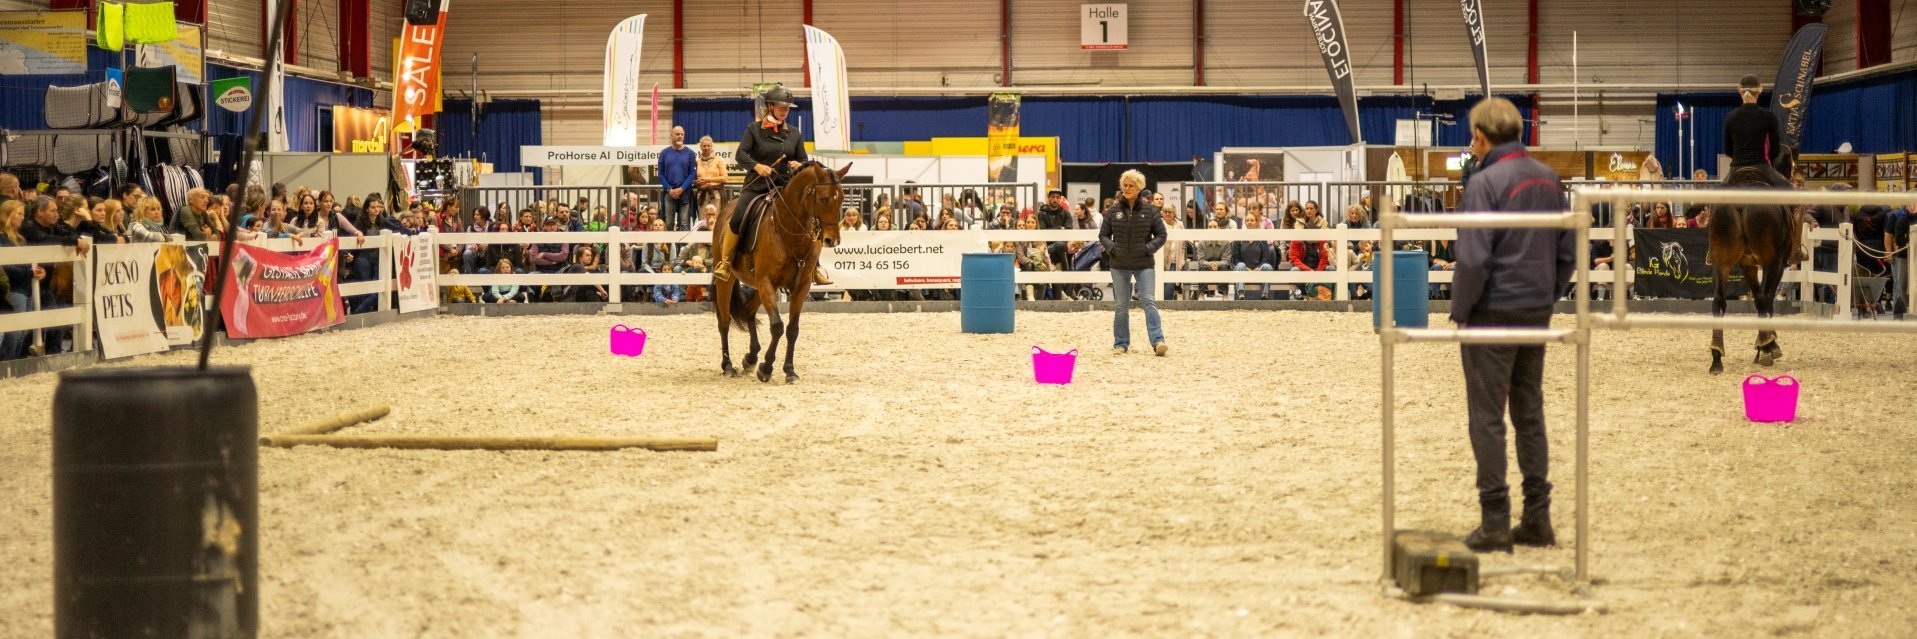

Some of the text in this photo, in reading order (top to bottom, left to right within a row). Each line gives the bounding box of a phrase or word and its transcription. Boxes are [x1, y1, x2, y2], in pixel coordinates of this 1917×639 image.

[1089, 6, 1119, 19] Halle
[1099, 20, 1108, 43] 1
[405, 25, 436, 107] SALE
[1793, 48, 1813, 99] SCHNABEL
[220, 96, 250, 105] STICKEREI
[547, 150, 659, 162] ProHorse AI Digitaler
[834, 243, 944, 255] www.luciaebert.net
[834, 260, 910, 270] 0171 34 65 156
[102, 293, 134, 319] PETS
